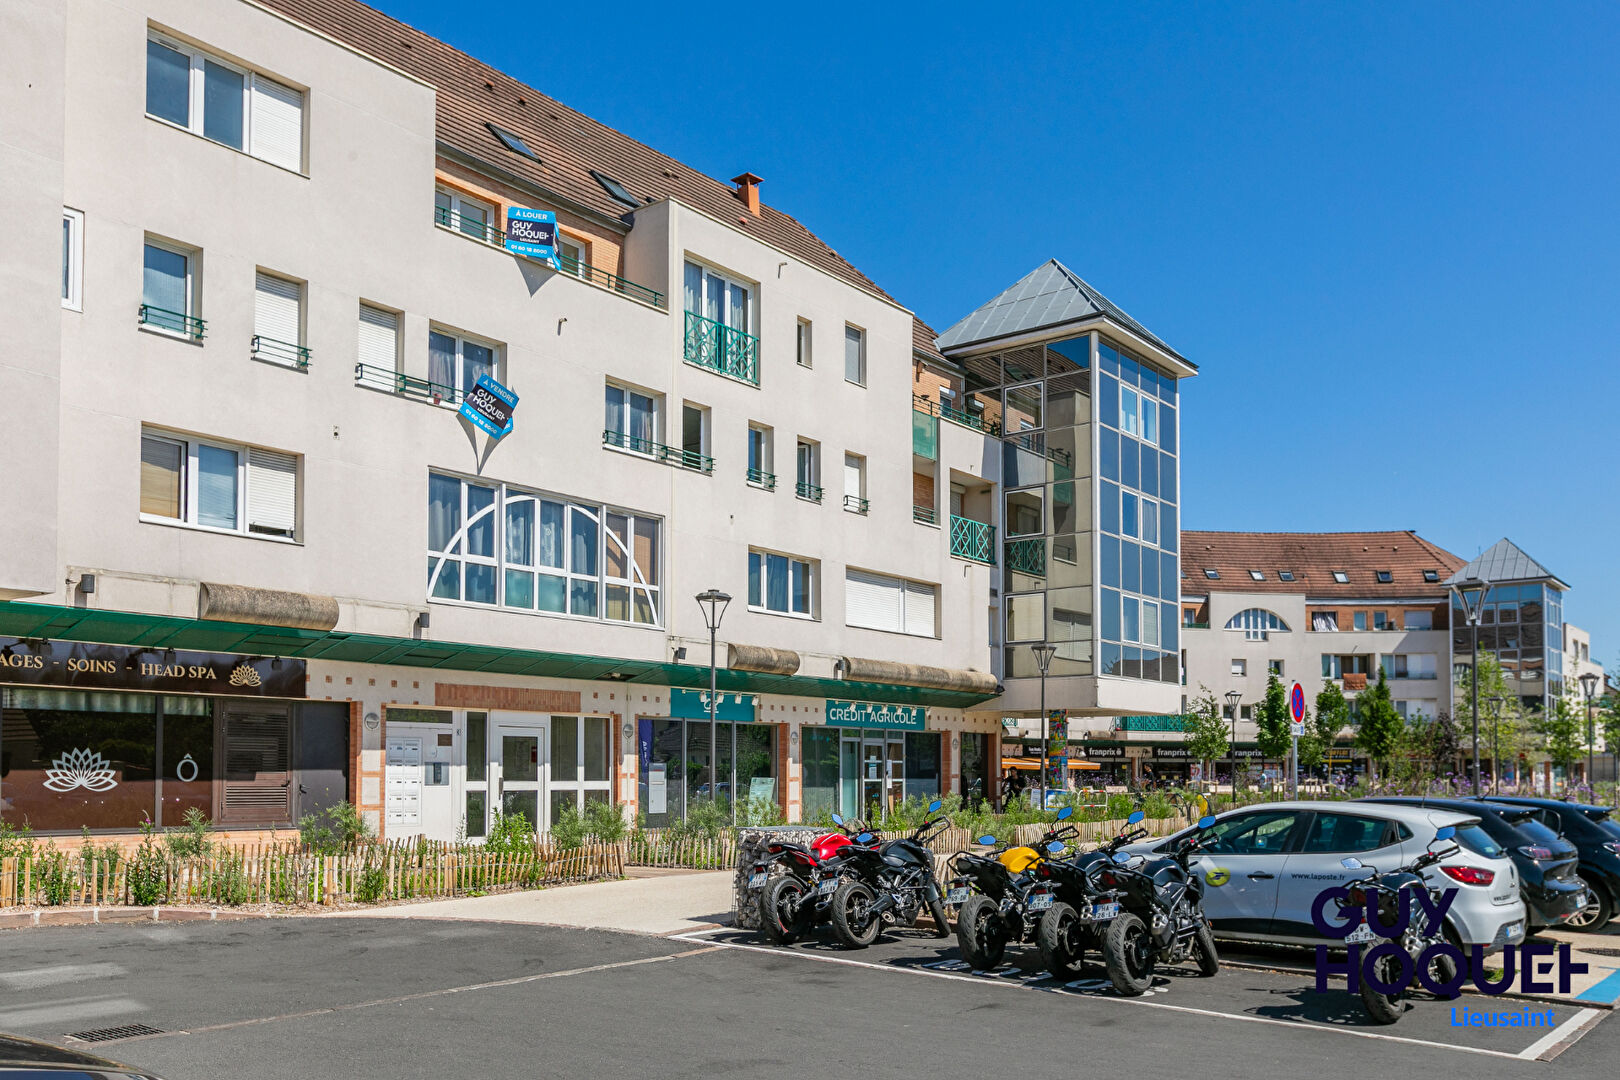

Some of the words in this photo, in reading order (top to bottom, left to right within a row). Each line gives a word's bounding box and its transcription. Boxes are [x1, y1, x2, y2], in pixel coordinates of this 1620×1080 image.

[523, 212, 548, 220] LOUER
[512, 220, 533, 230] GUY
[477, 389, 497, 404] GUY
[490, 382, 515, 404] VENDRE
[67, 657, 117, 674] SOINS
[141, 662, 186, 678] HEAD
[188, 665, 217, 679] SPA
[829, 707, 867, 722] CRÉDIT
[869, 710, 917, 725] AGRICOLE
[1089, 748, 1116, 757] franprix
[1157, 748, 1187, 757] franprix
[1234, 749, 1263, 758] ranprix
[1291, 873, 1346, 881] www.laposte.fr
